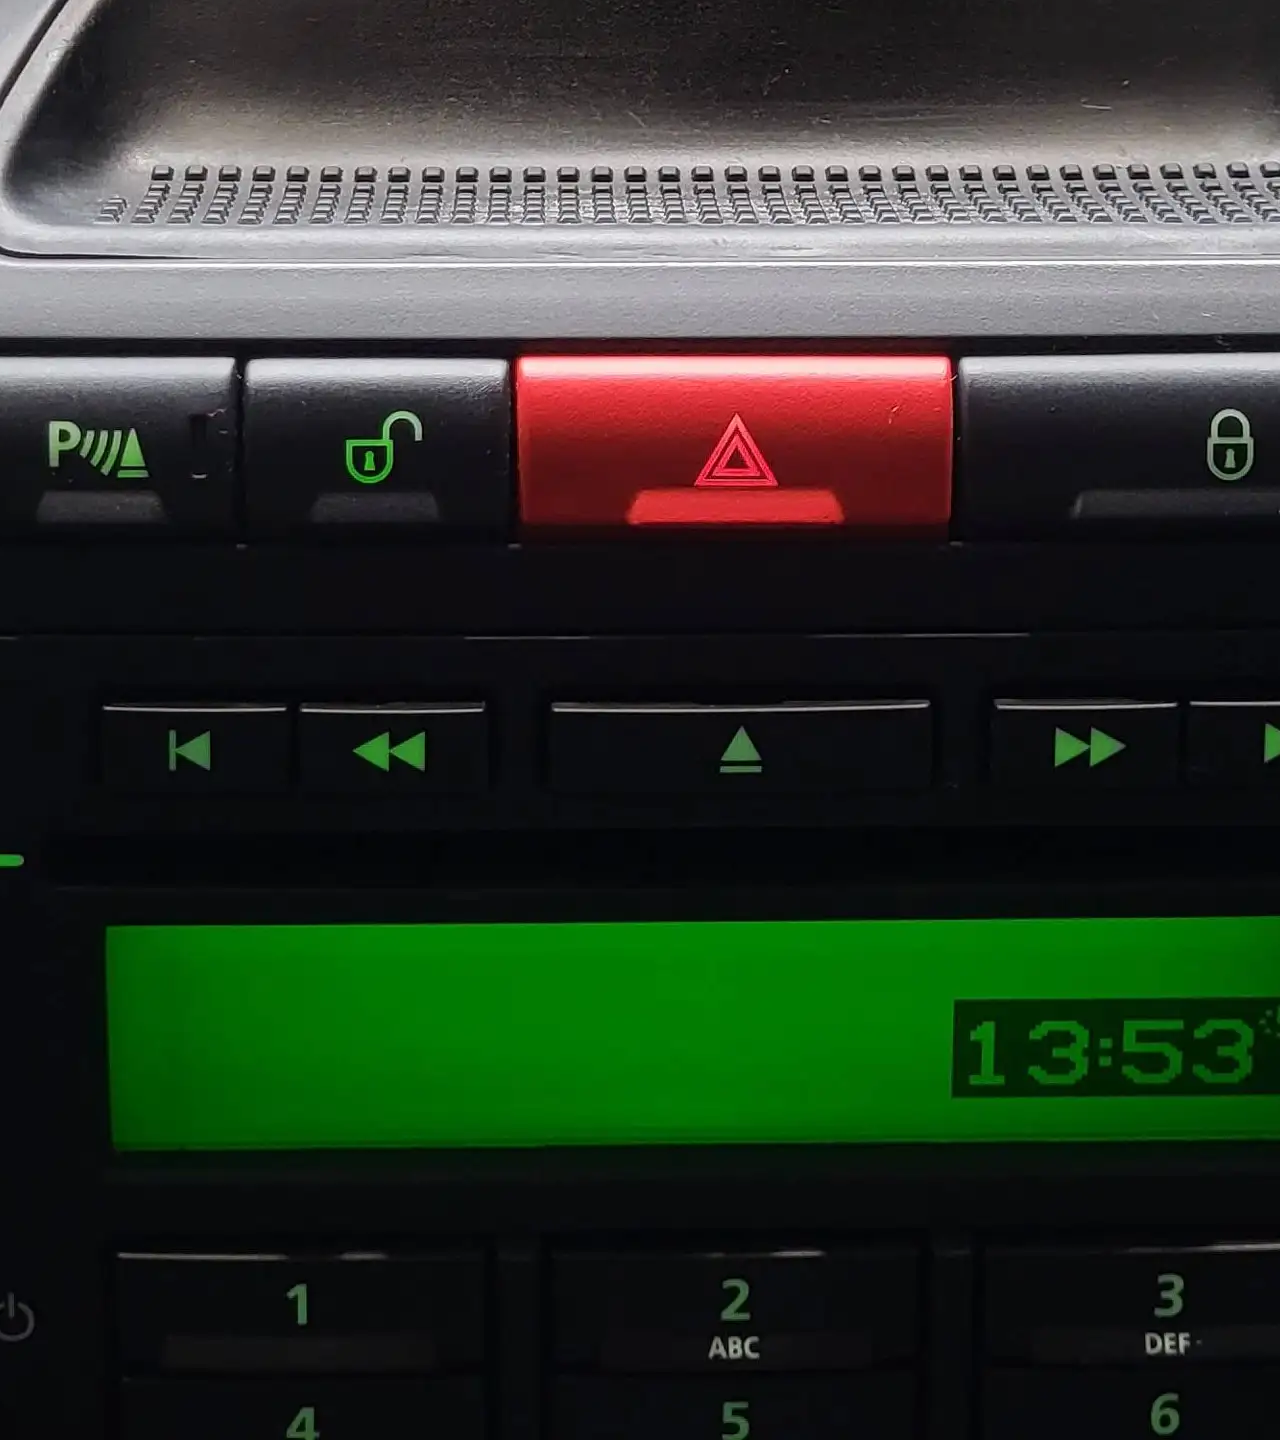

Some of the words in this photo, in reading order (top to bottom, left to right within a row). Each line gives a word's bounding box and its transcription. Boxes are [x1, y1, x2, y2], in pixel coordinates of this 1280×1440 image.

[968, 1019, 1254, 1086] 13:53
[286, 1283, 308, 1325] 1
[721, 1278, 751, 1321] 2
[1154, 1274, 1185, 1318] 3
[708, 1336, 760, 1360] ABC
[1145, 1332, 1190, 1355] DEF
[286, 1407, 320, 1440] 4
[721, 1401, 750, 1440] 5
[1150, 1393, 1180, 1435] 6
